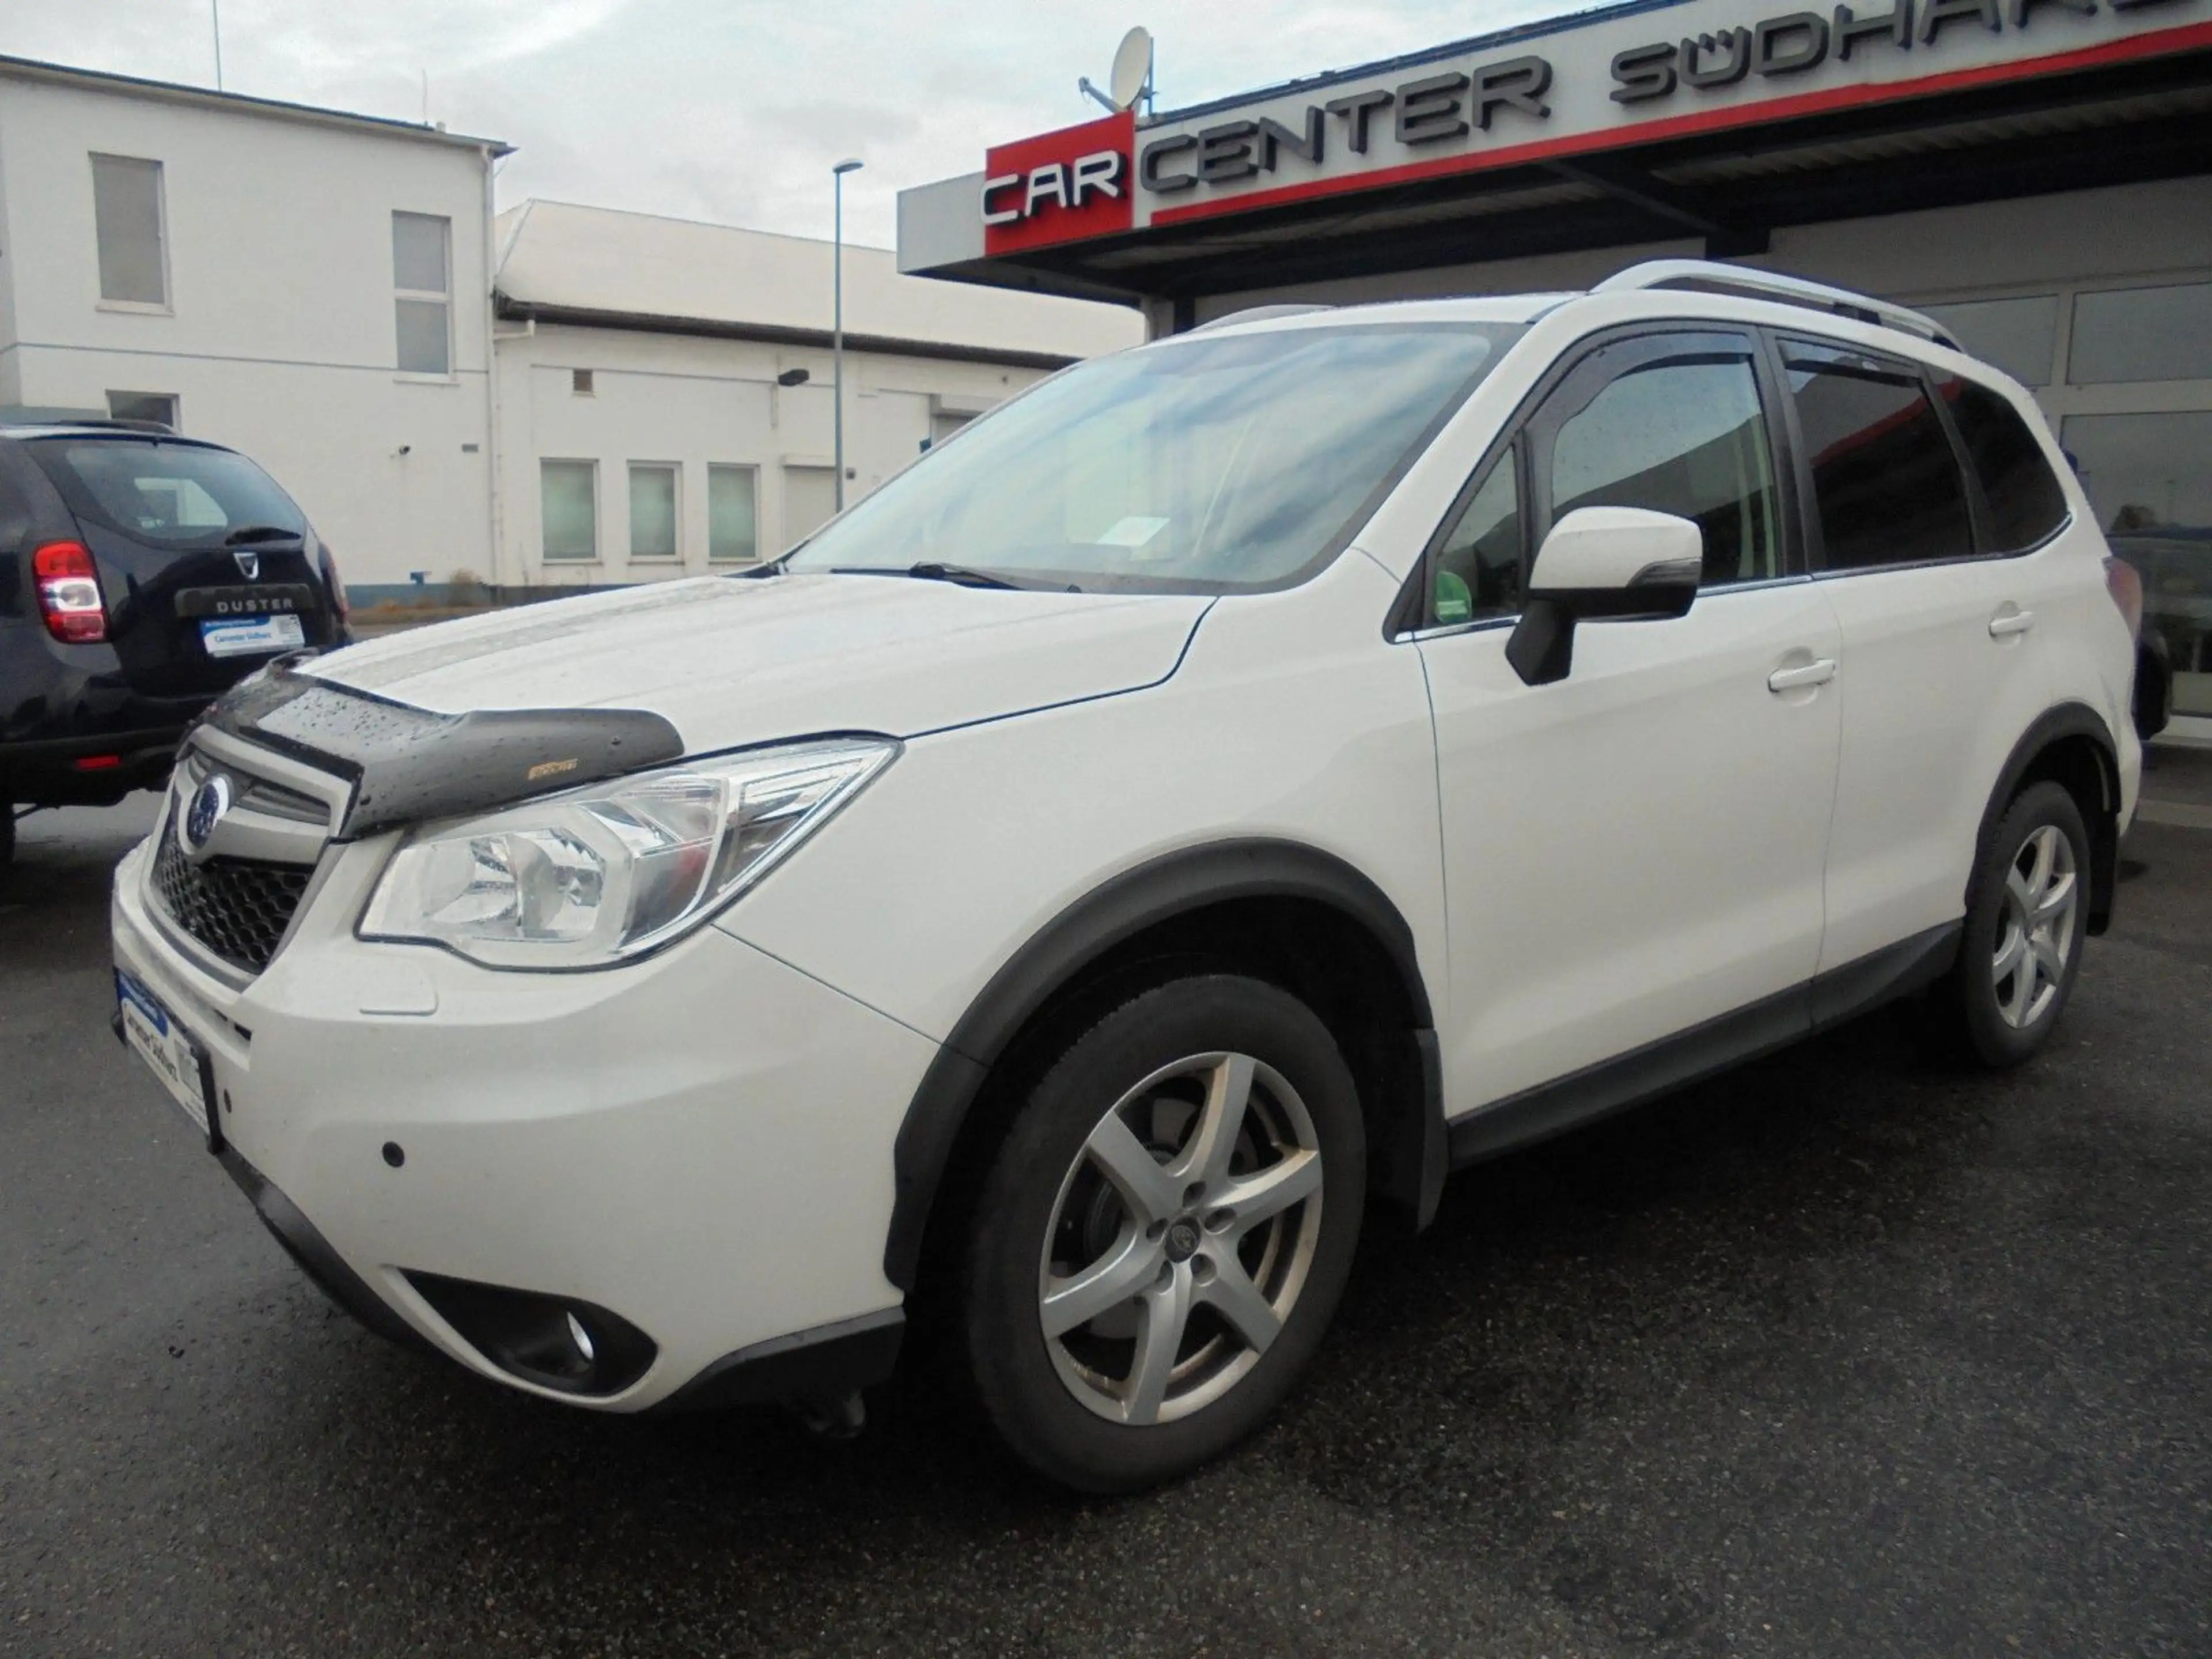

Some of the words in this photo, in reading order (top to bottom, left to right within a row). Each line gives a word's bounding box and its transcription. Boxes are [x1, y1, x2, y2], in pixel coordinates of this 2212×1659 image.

[980, 149, 1121, 225] CAR
[1139, 55, 1553, 194] CENTER
[1609, 0, 2187, 103] SÜDHA
[217, 599, 293, 613] DUSTER
